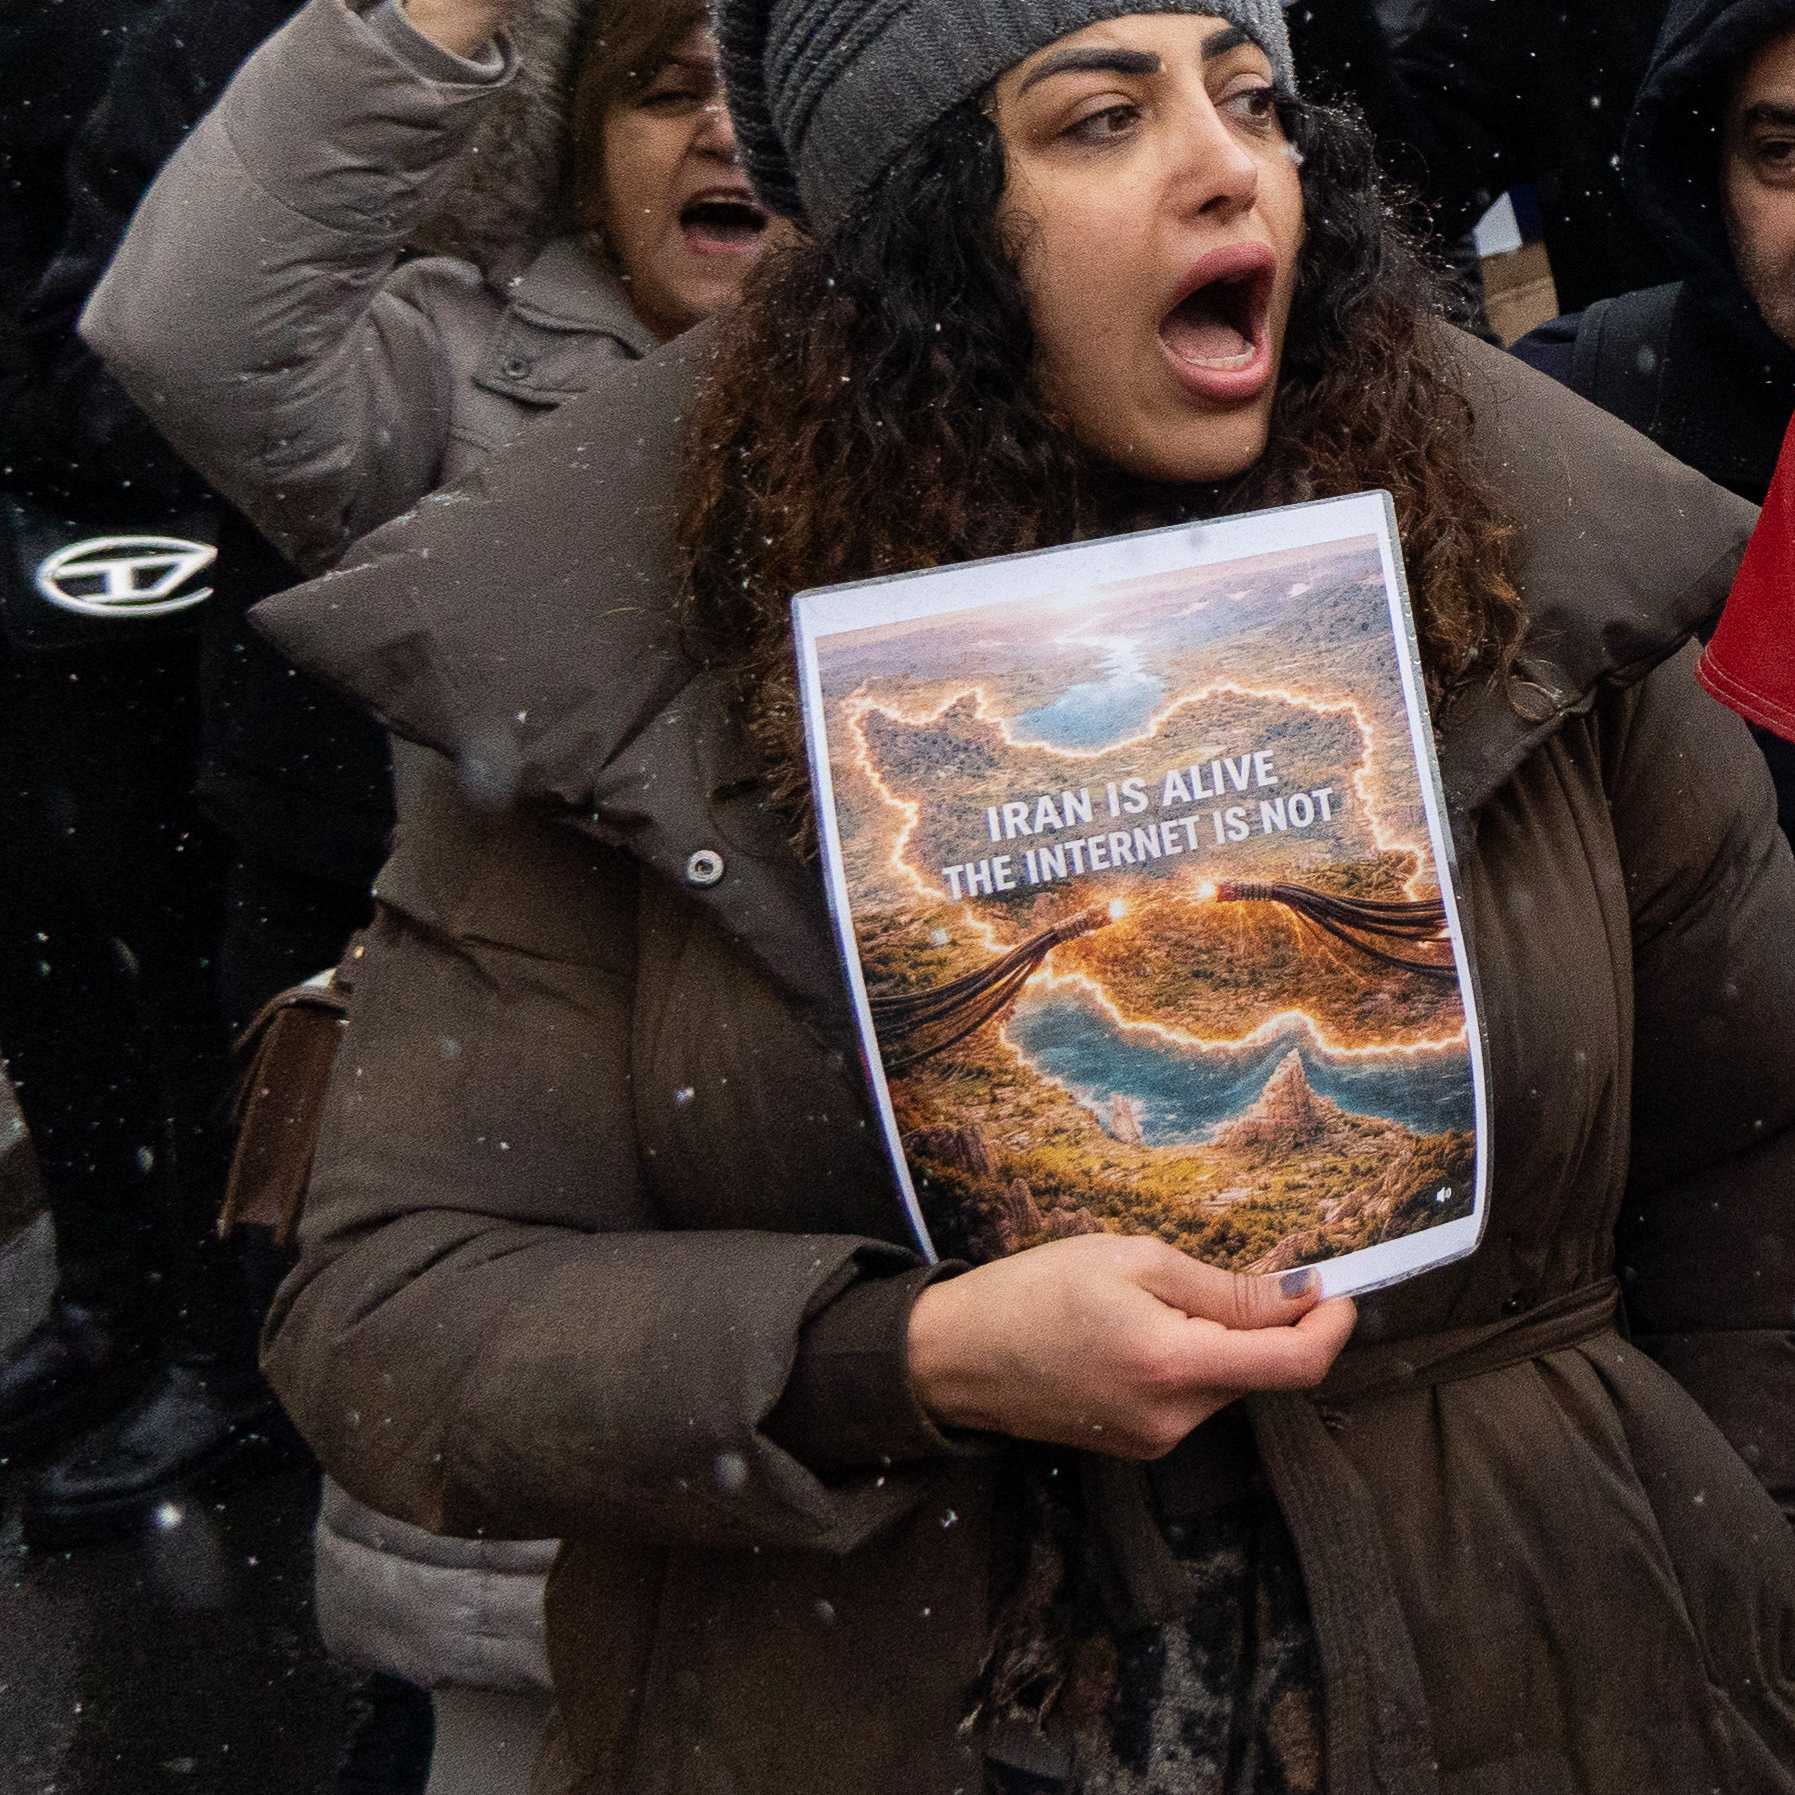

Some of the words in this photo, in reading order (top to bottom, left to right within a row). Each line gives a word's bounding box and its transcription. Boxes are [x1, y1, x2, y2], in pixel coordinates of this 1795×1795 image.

[942, 854, 1017, 902] THE
[1026, 815, 1201, 886] INTERNET
[1212, 806, 1250, 845] IS
[1259, 787, 1335, 835] NOT
[986, 786, 1093, 843] IRAN
[1107, 776, 1149, 817] IS
[1160, 749, 1279, 807] ALIVE
